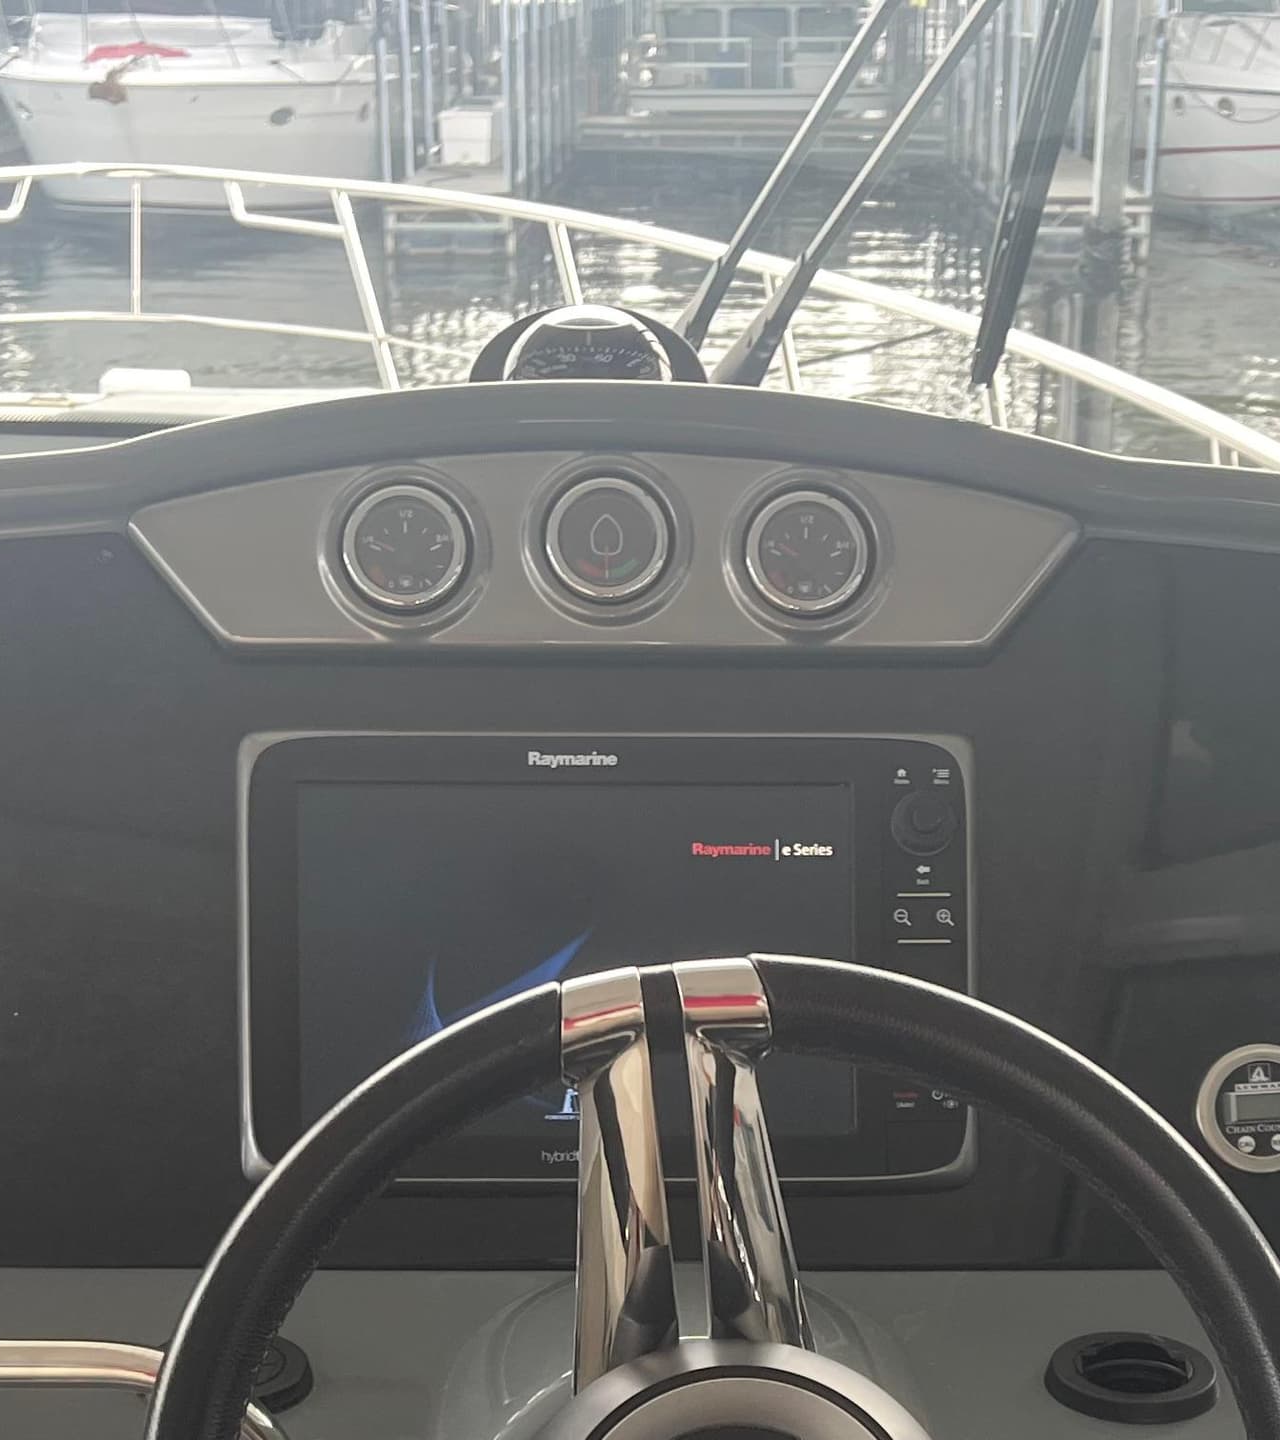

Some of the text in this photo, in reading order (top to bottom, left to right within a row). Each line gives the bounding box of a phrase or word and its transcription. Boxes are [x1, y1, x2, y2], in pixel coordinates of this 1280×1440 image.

[527, 750, 619, 769] Raymarine
[692, 842, 834, 858] Raymarine e Series
